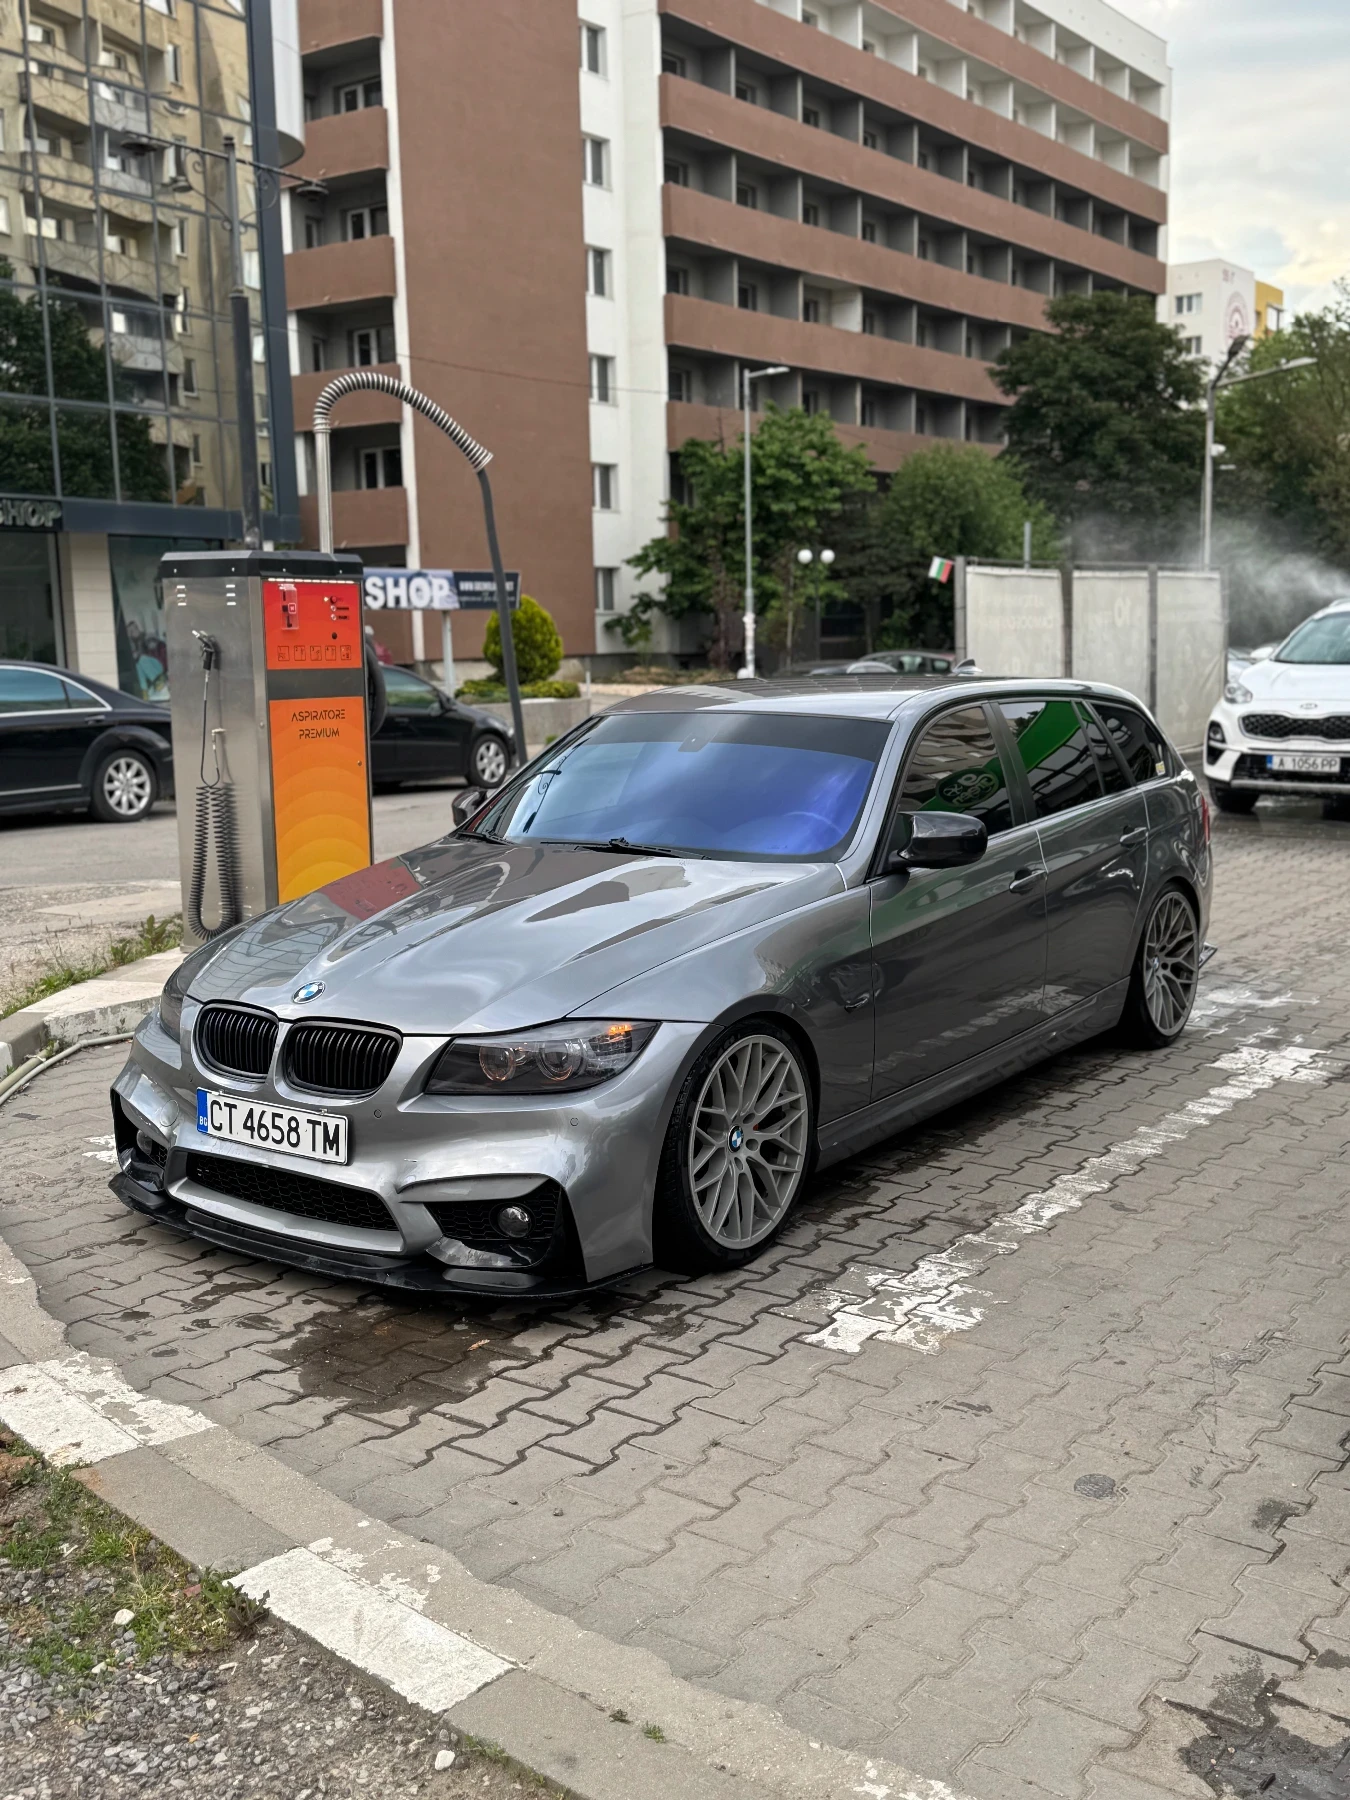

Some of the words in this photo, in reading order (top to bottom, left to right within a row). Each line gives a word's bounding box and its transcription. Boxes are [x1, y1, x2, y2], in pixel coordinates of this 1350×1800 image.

[0, 499, 62, 527] HOP
[365, 576, 450, 610] SHOP
[291, 709, 346, 722] ASPIRATORE
[299, 729, 340, 740] PREMIUM
[1278, 758, 1285, 767] A
[1292, 758, 1319, 770] 1056
[1321, 759, 1337, 770] PP
[199, 1115, 208, 1127] BG
[209, 1099, 238, 1135] CT
[242, 1107, 301, 1148] 4658
[306, 1118, 340, 1157] TM
